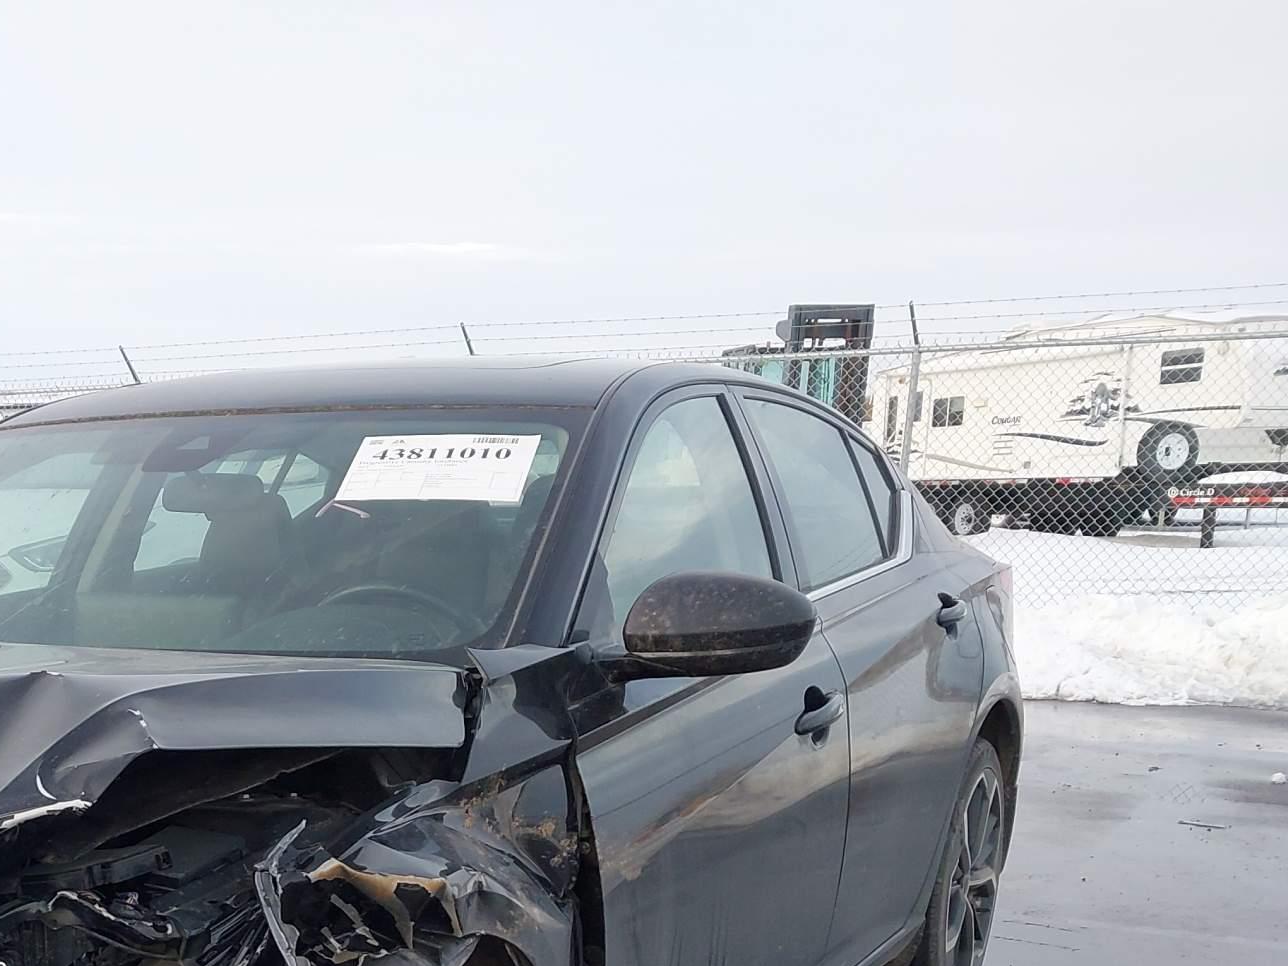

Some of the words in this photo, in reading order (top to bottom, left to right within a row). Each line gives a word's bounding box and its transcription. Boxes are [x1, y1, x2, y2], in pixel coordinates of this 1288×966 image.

[372, 447, 512, 460] 43811010
[1180, 487, 1205, 497] Circle
[1207, 487, 1215, 496] D
